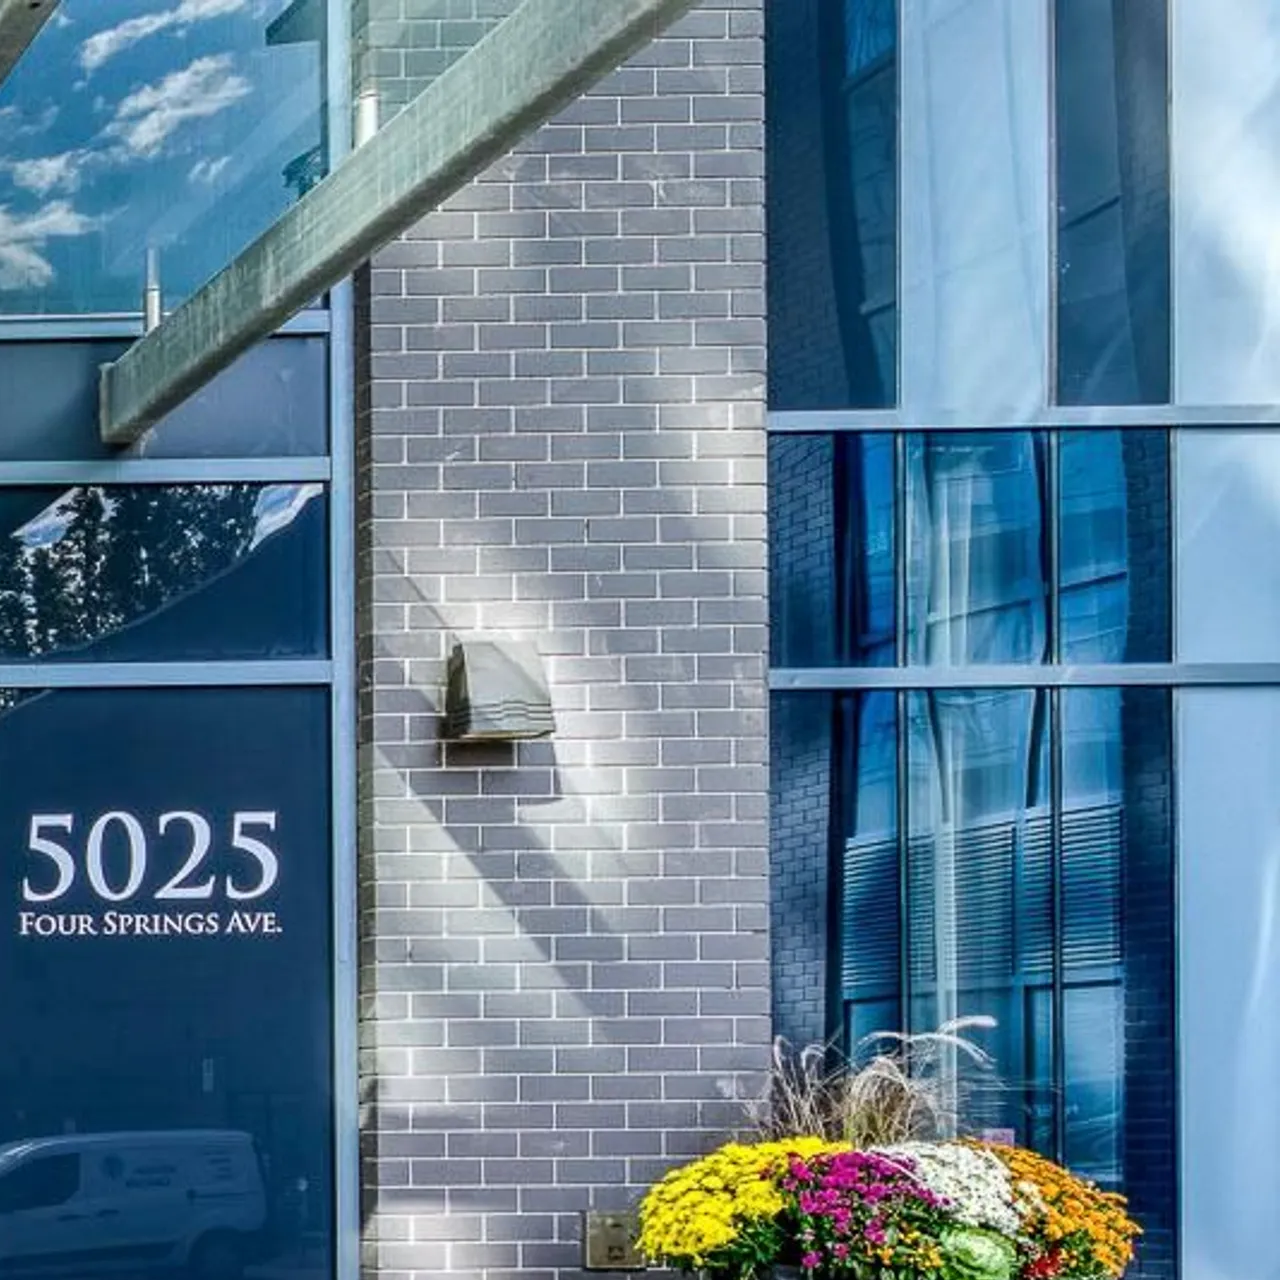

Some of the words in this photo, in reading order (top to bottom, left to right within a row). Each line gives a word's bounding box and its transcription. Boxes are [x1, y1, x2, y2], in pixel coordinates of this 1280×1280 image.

[22, 810, 279, 902] 5025
[19, 911, 97, 935] FOUR
[104, 910, 218, 935] SPRINGS
[225, 910, 283, 934] AVE.
